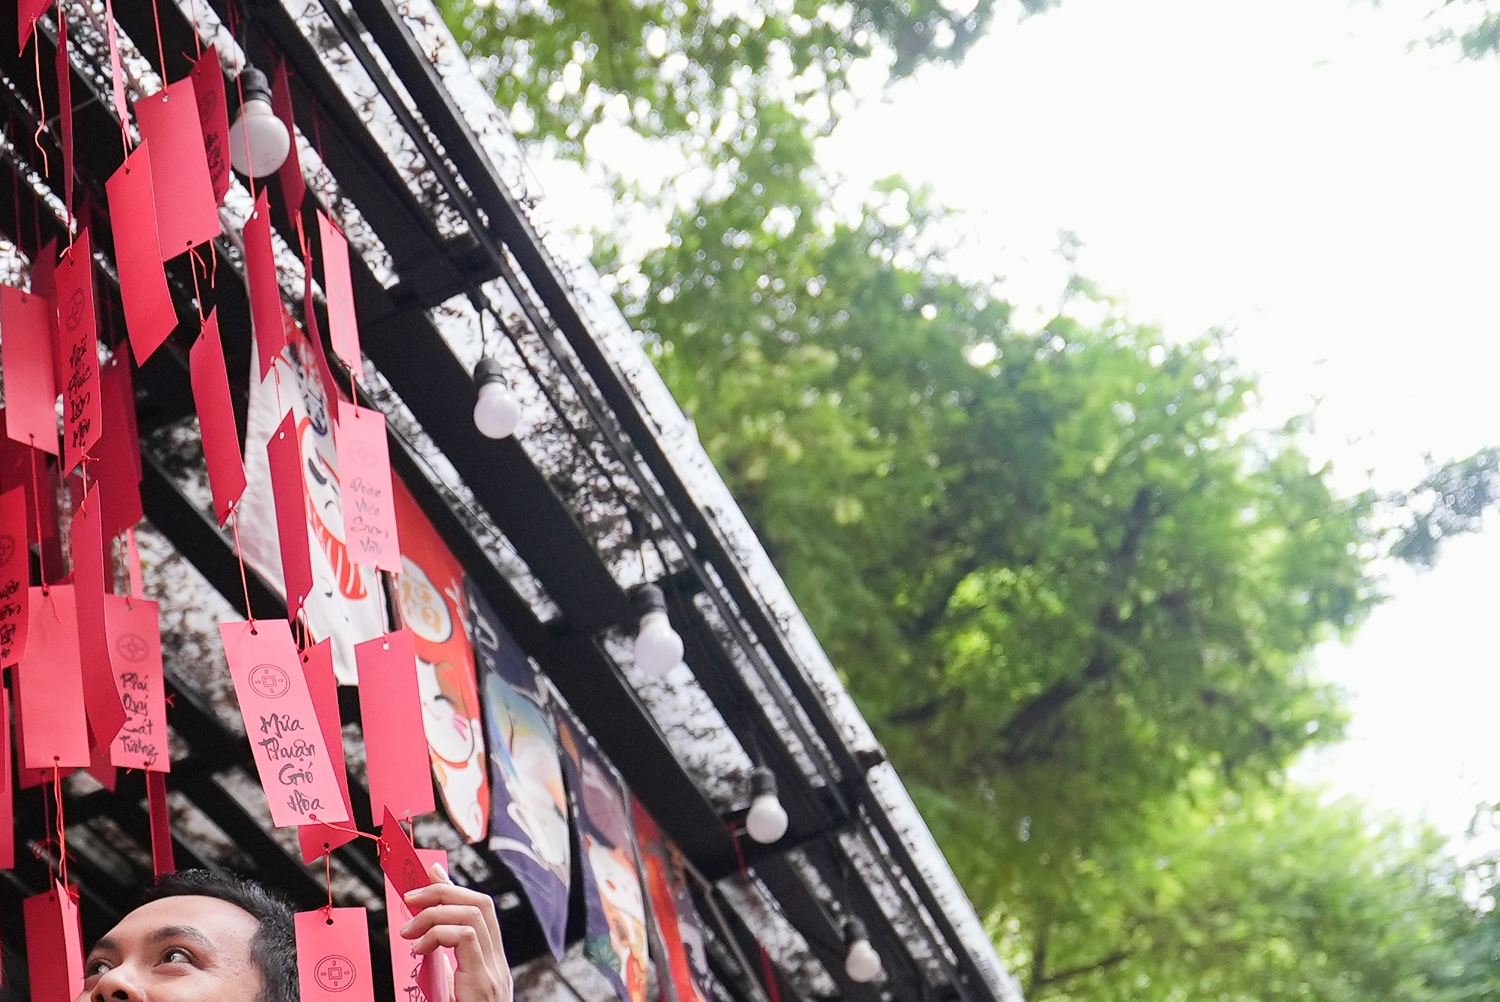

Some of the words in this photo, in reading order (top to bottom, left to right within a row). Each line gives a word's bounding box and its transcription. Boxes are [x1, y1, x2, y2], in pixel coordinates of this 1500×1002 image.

[260, 713, 304, 738] Mưa
[258, 737, 315, 761] Thuận
[278, 761, 313, 785] Gió
